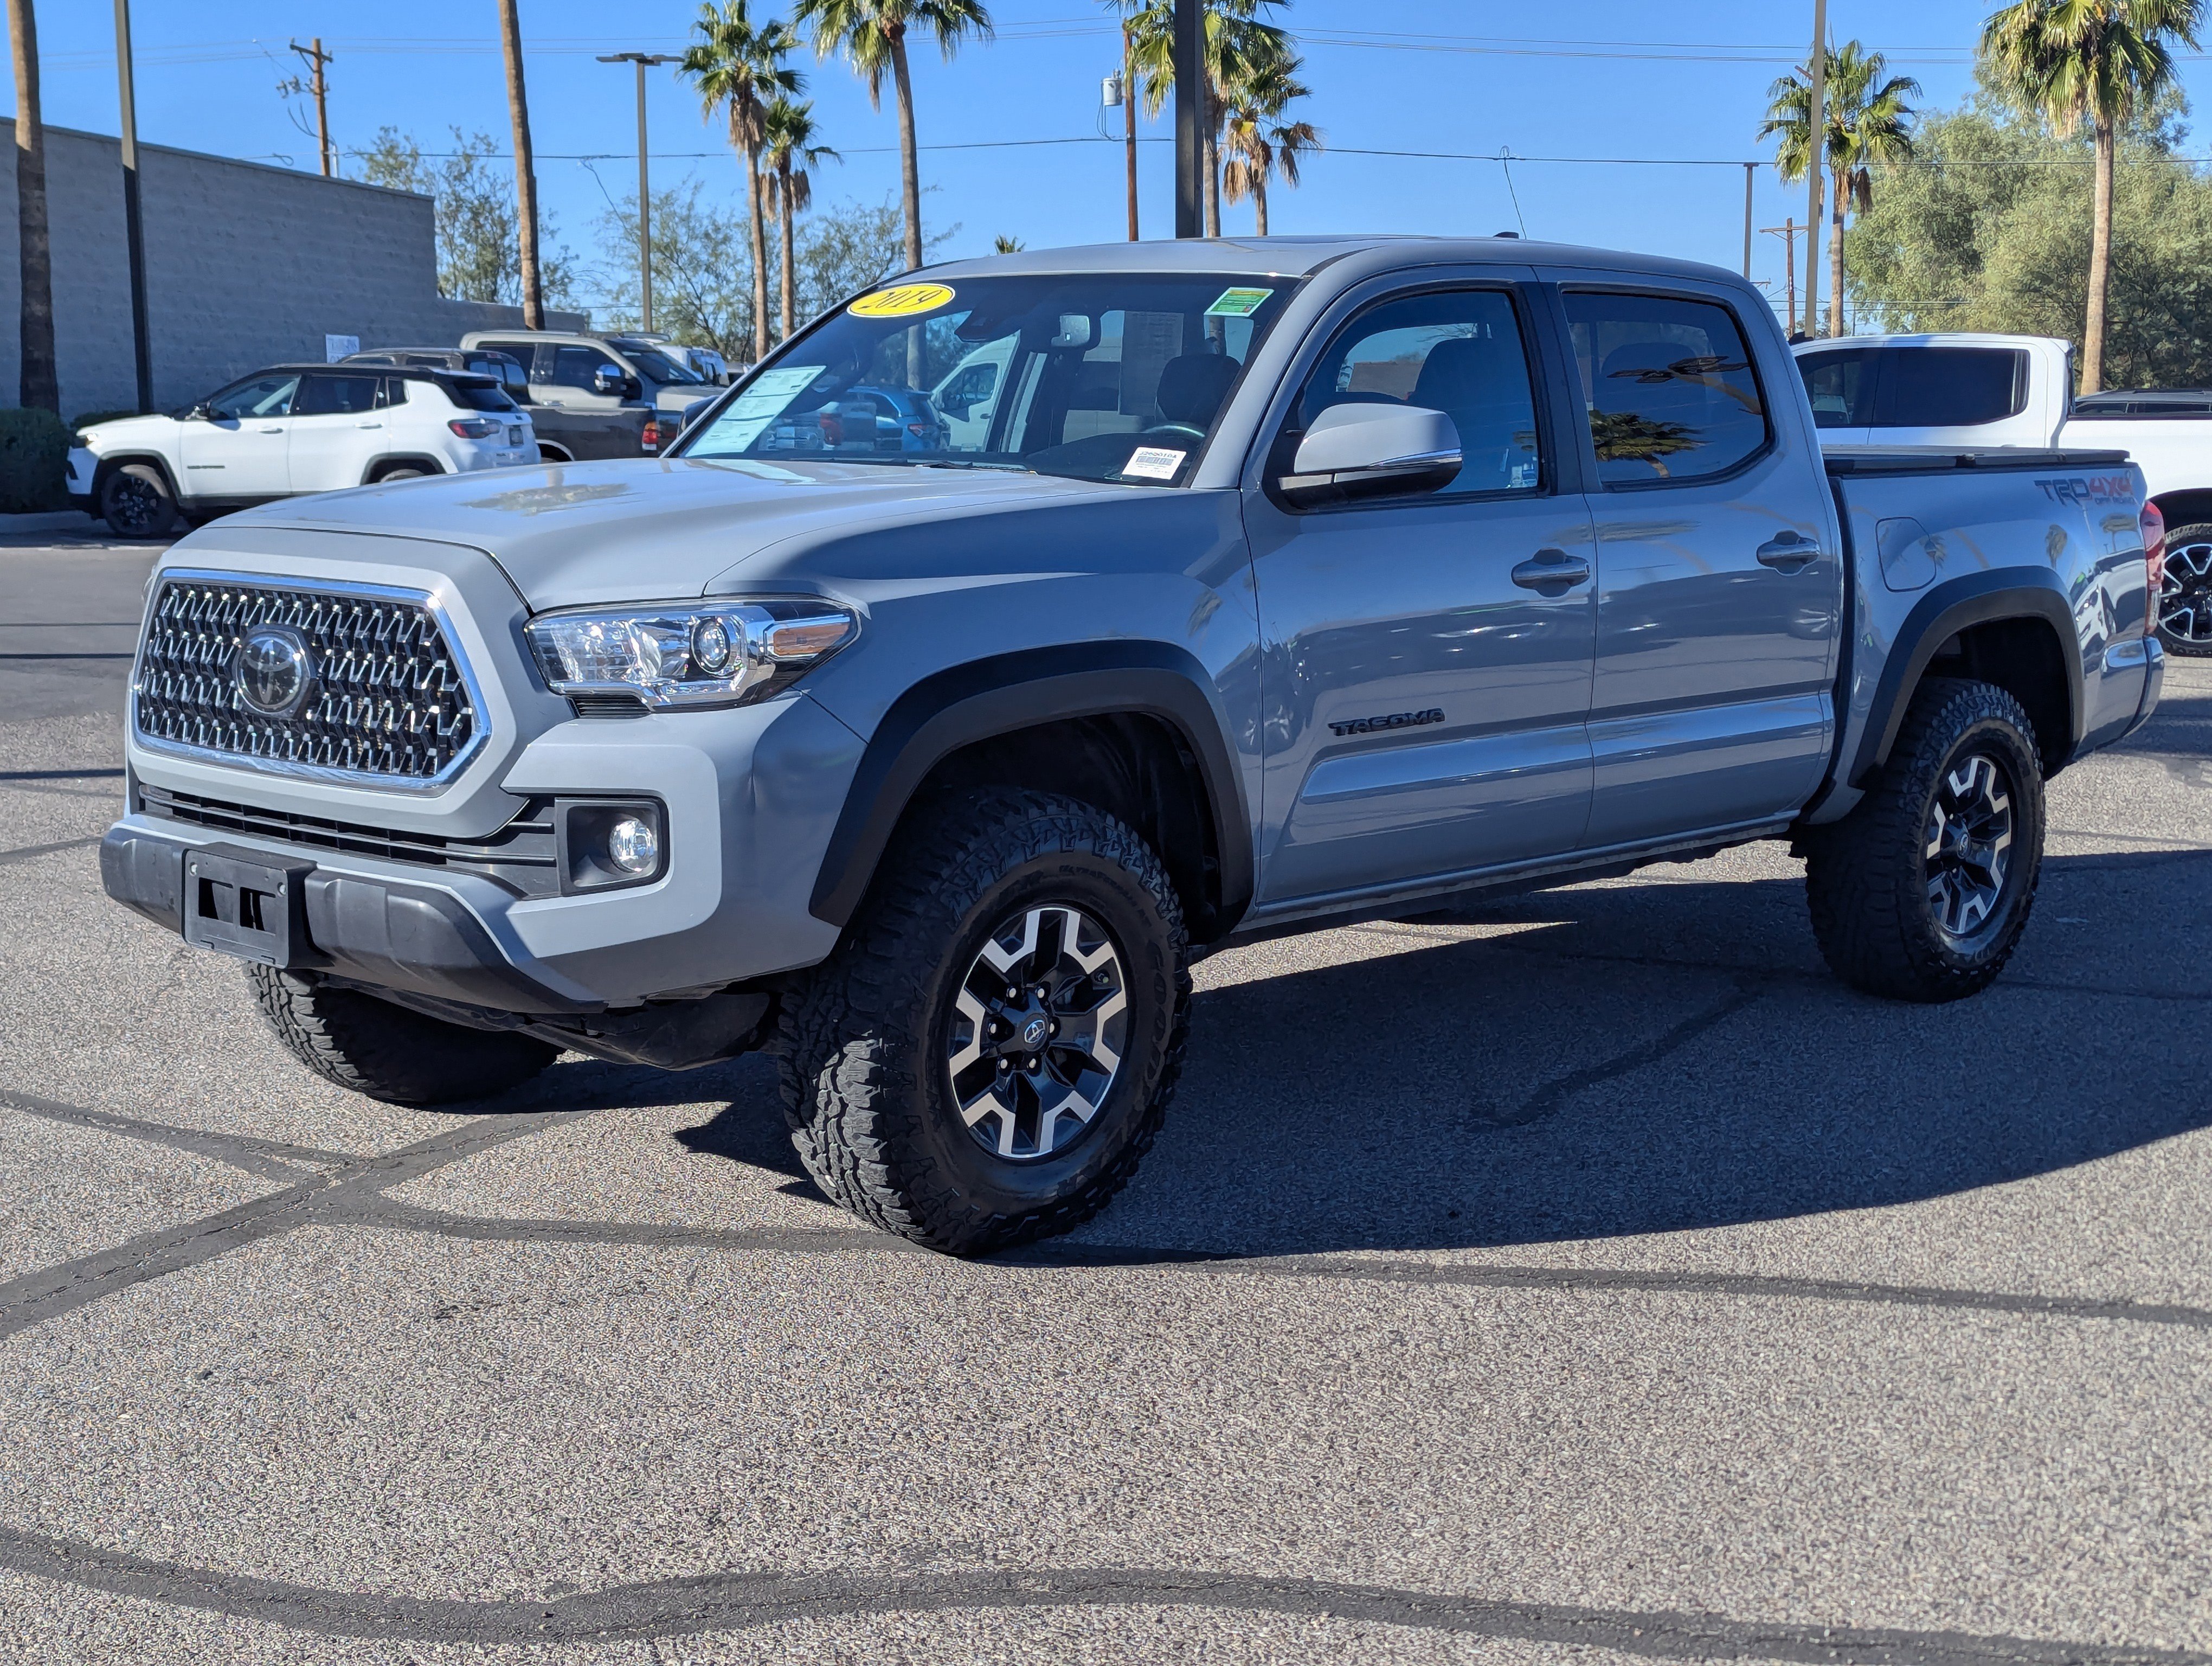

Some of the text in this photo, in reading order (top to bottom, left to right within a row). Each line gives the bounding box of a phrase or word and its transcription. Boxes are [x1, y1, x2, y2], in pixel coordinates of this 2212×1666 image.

[857, 290, 943, 309] 2019
[2034, 478, 2090, 505] TRD
[1328, 707, 1445, 736] TACOMA
